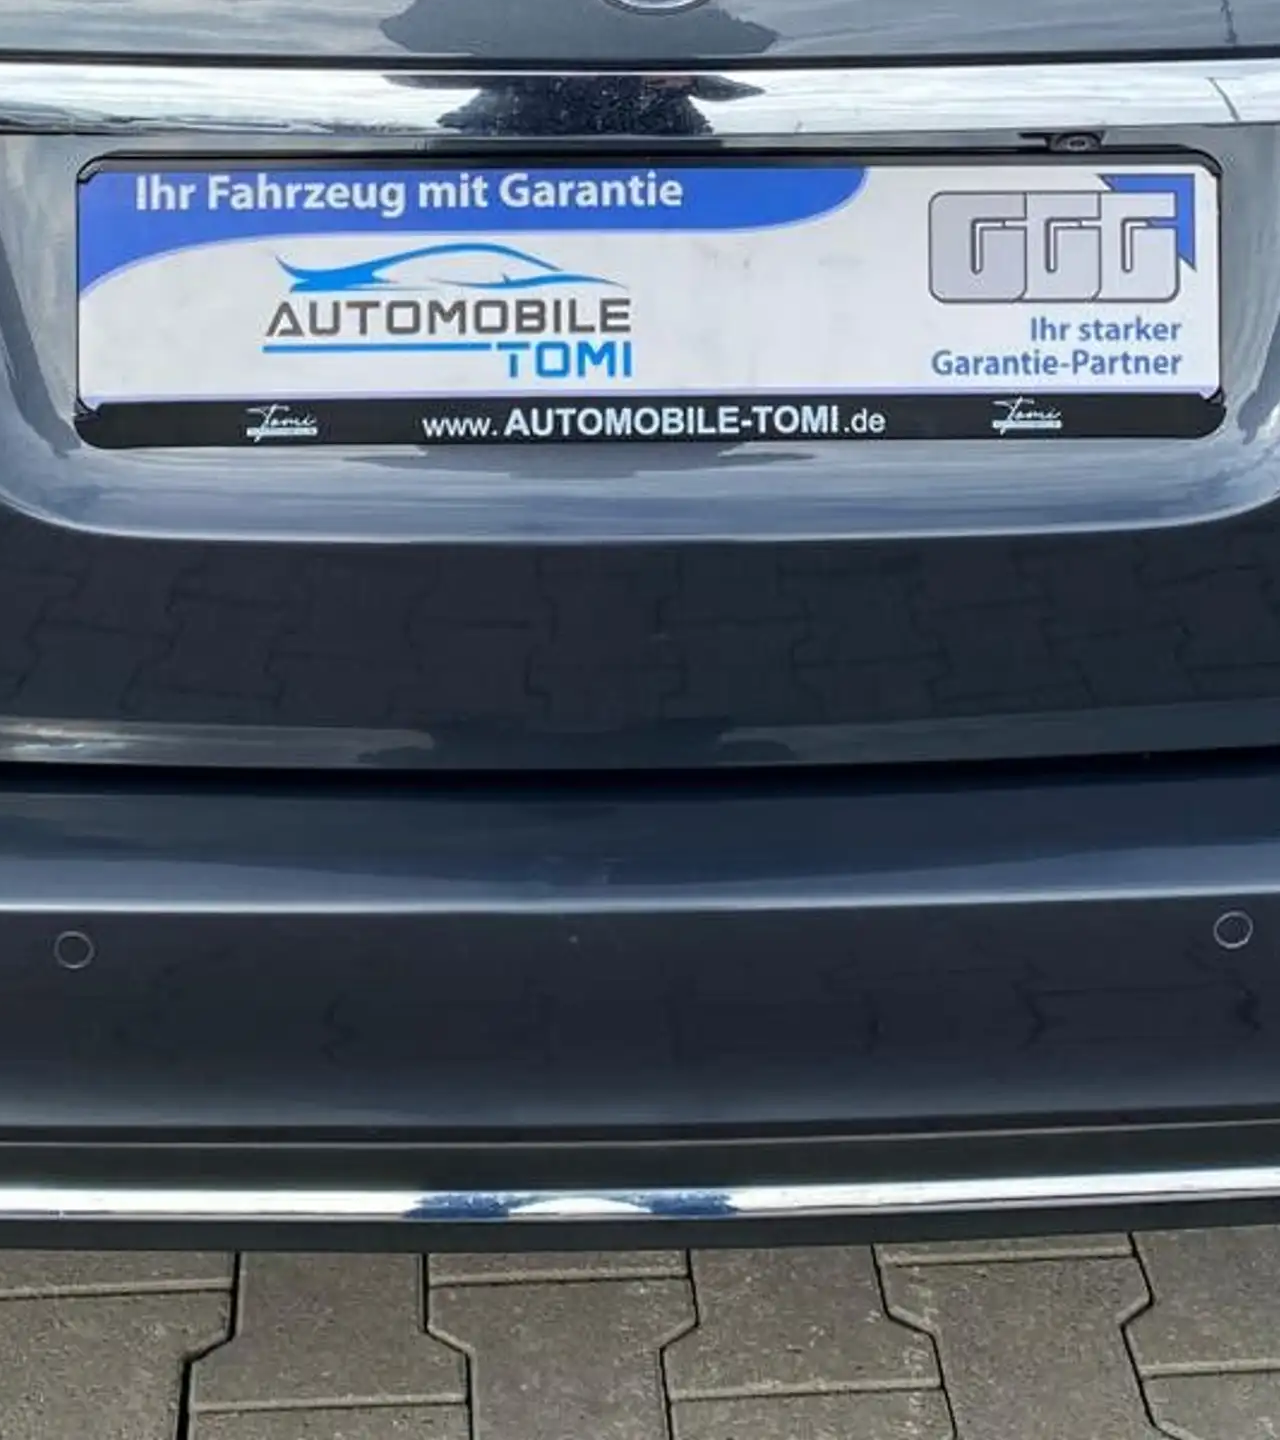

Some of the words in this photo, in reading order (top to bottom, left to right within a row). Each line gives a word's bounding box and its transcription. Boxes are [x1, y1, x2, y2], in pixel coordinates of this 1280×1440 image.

[135, 173, 196, 210] Ihr
[208, 172, 406, 218] Fahrzeug
[418, 172, 489, 209] mit
[499, 171, 683, 208] Garantie
[265, 298, 631, 337] AUTOMOBILE
[1030, 316, 1071, 341] Ihr
[1078, 315, 1182, 341] starker
[496, 341, 631, 378] TOMI
[931, 349, 1182, 376] Garantie-Partner
